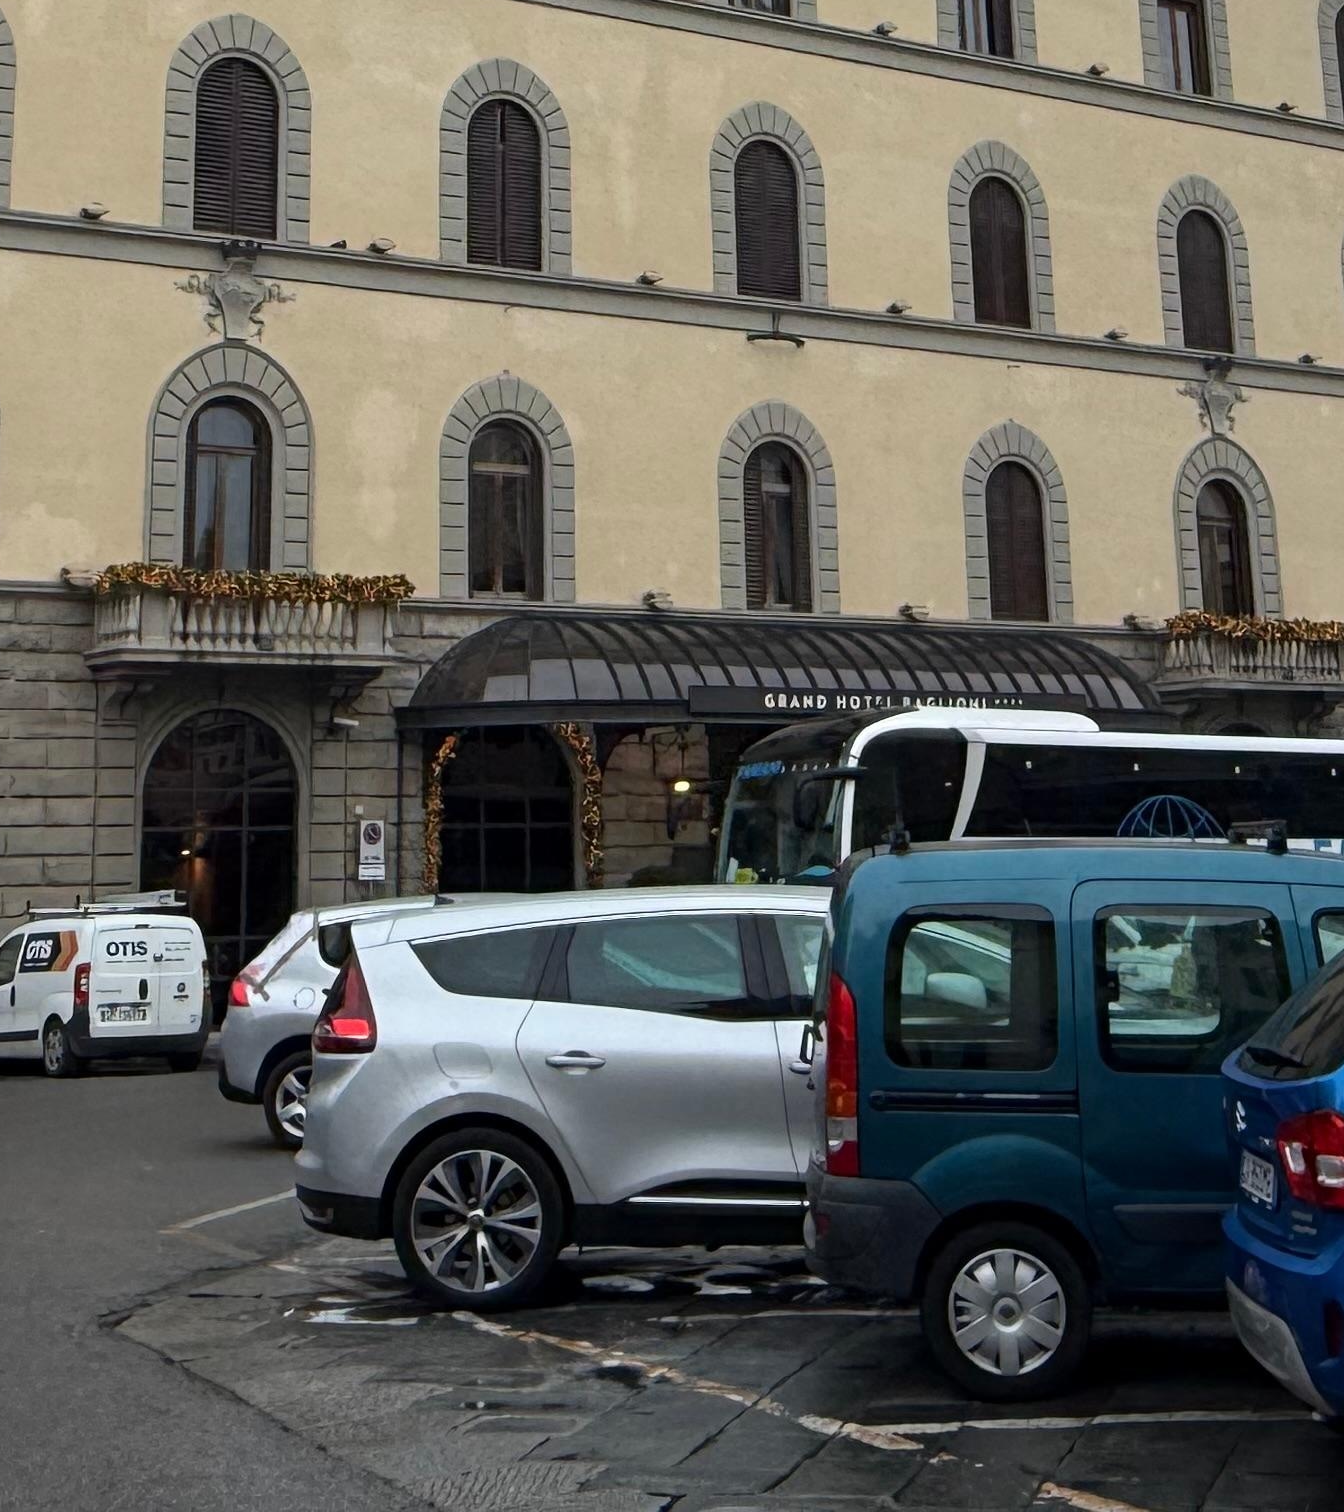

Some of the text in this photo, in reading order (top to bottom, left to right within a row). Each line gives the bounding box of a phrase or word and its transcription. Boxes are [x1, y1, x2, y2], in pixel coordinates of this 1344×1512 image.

[764, 693, 827, 709] GRAND
[26, 939, 53, 960] OTIS
[106, 941, 148, 956] OTIS
